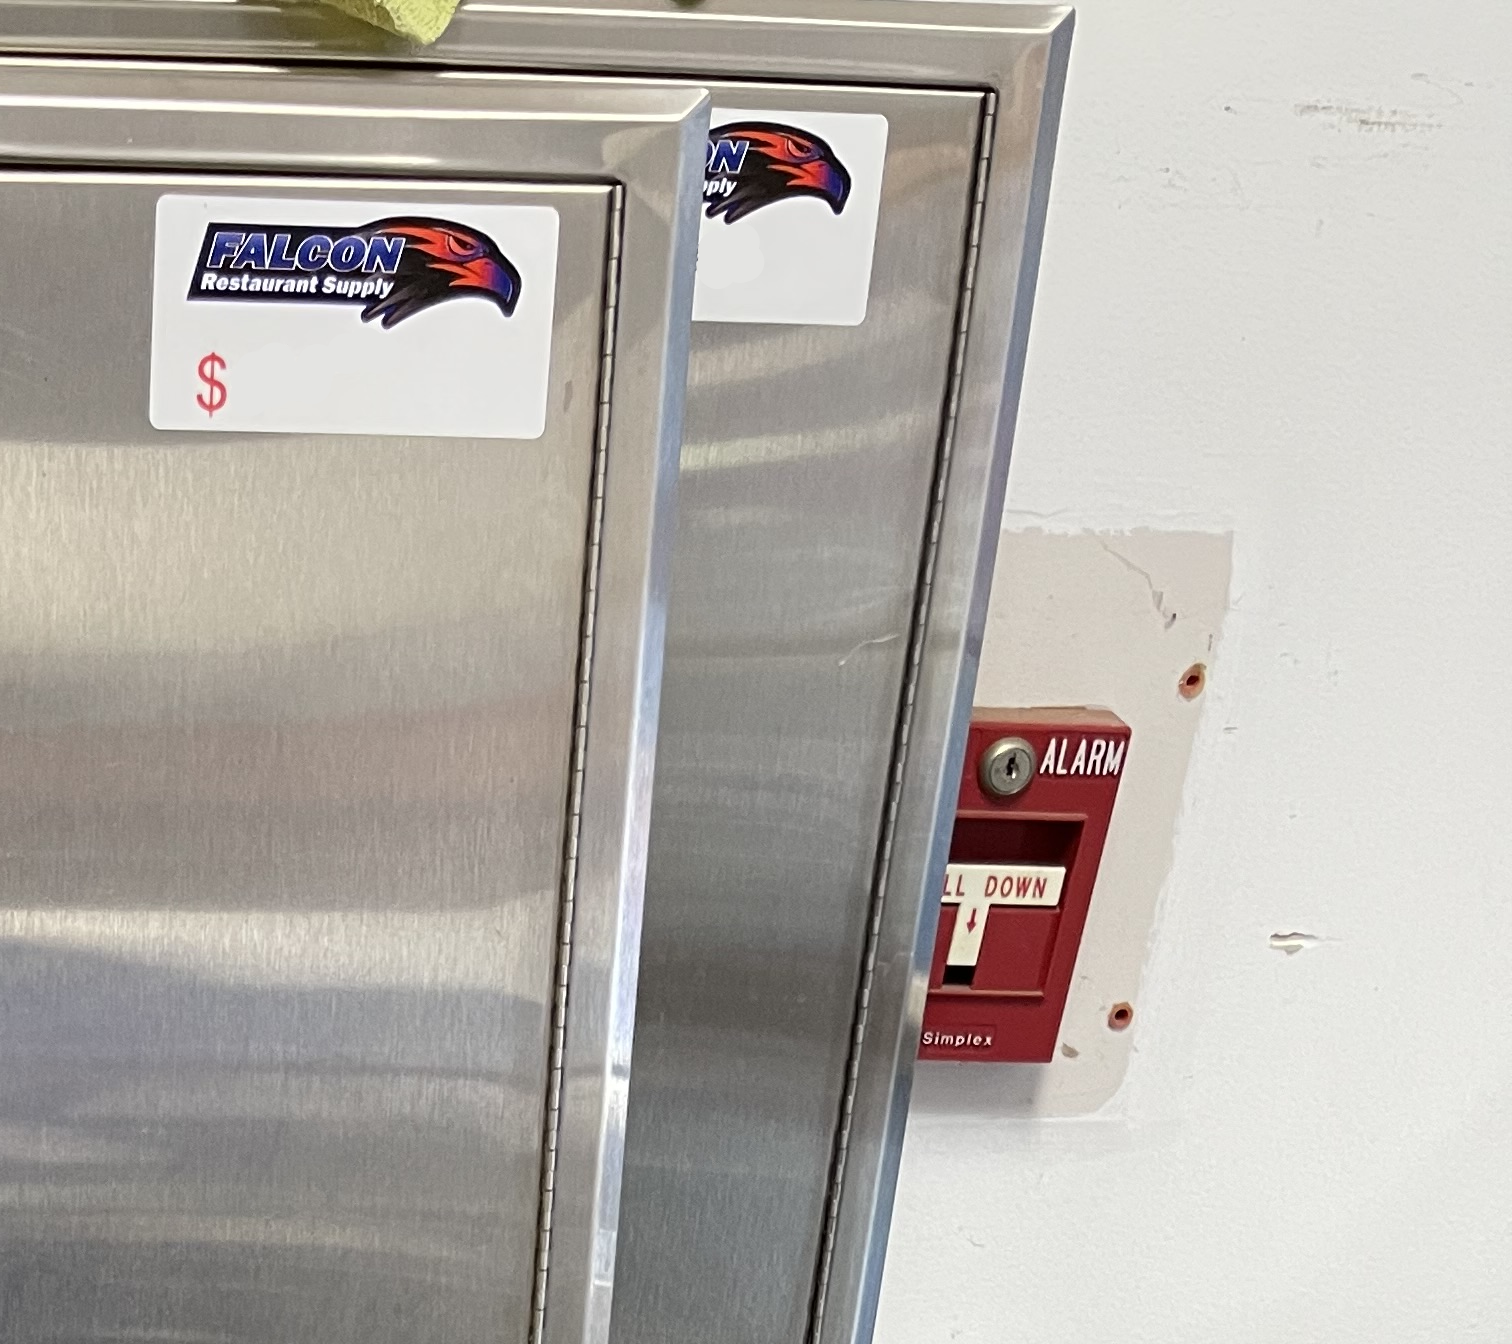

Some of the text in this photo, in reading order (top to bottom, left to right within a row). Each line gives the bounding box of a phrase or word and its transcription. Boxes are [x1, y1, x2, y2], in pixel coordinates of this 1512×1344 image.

[206, 231, 406, 274] FALCON
[200, 273, 395, 298] Restaurant Supply
[195, 352, 228, 418] $
[1039, 737, 1125, 776] ALARM
[985, 875, 1047, 899] DOWN
[922, 1031, 992, 1047] Simplex
